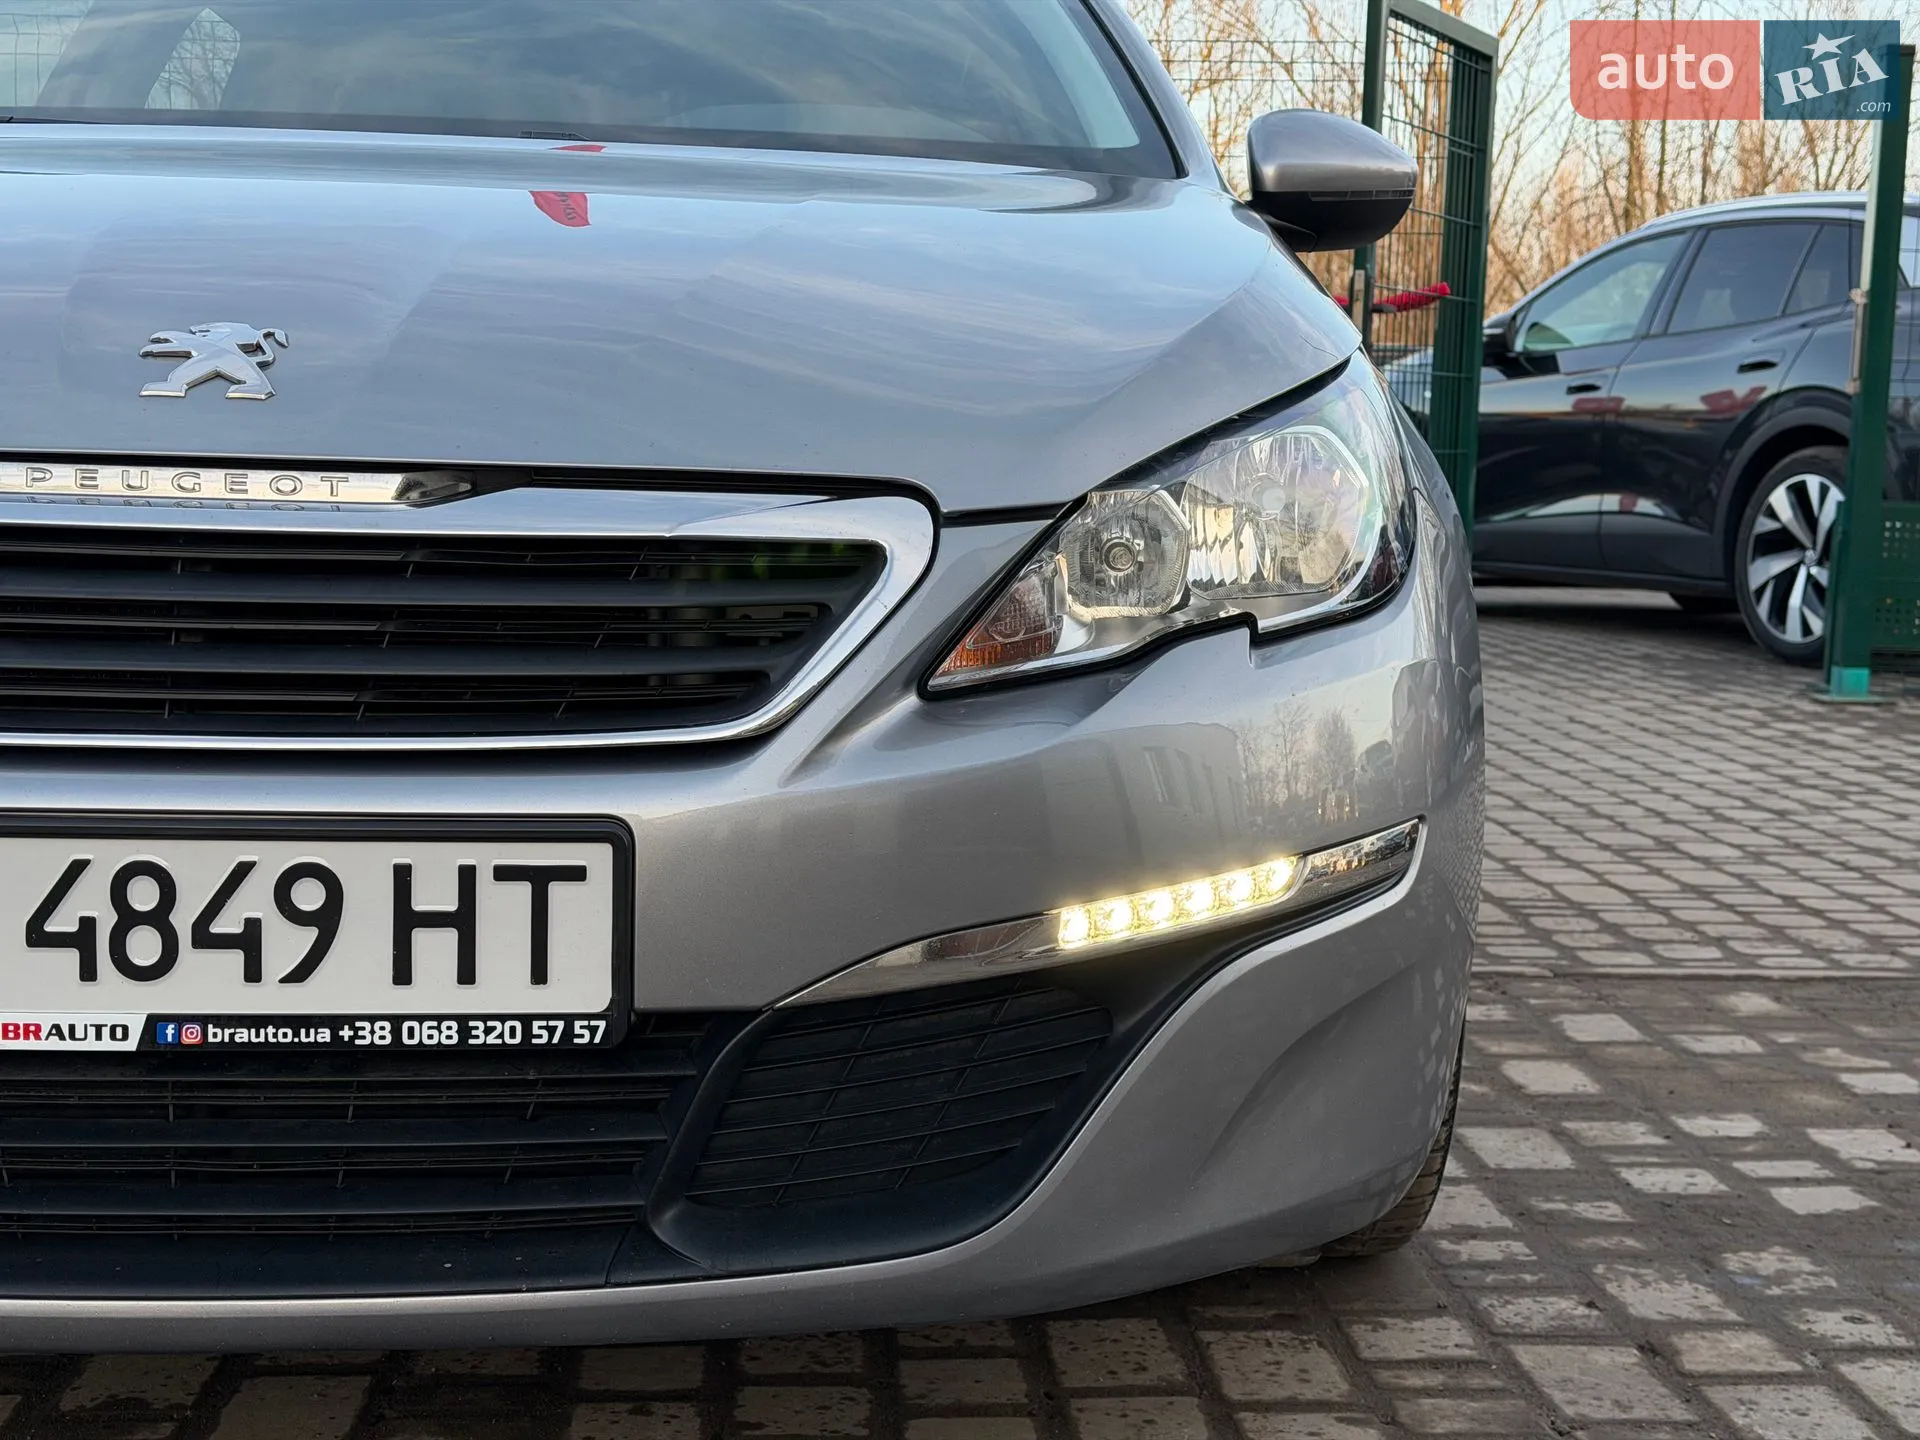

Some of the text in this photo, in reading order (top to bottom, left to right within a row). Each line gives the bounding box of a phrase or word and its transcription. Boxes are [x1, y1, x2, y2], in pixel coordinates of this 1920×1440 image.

[25, 466, 349, 498] PEUGEOT
[25, 855, 588, 986] 4849 HT
[1, 1022, 130, 1042] BRAUTO
[207, 1024, 331, 1043] brauto.ua
[338, 1021, 392, 1045] +38
[401, 1020, 459, 1045] 068
[468, 1020, 522, 1045] 320
[531, 1020, 565, 1044] 57
[573, 1020, 607, 1044] 57
